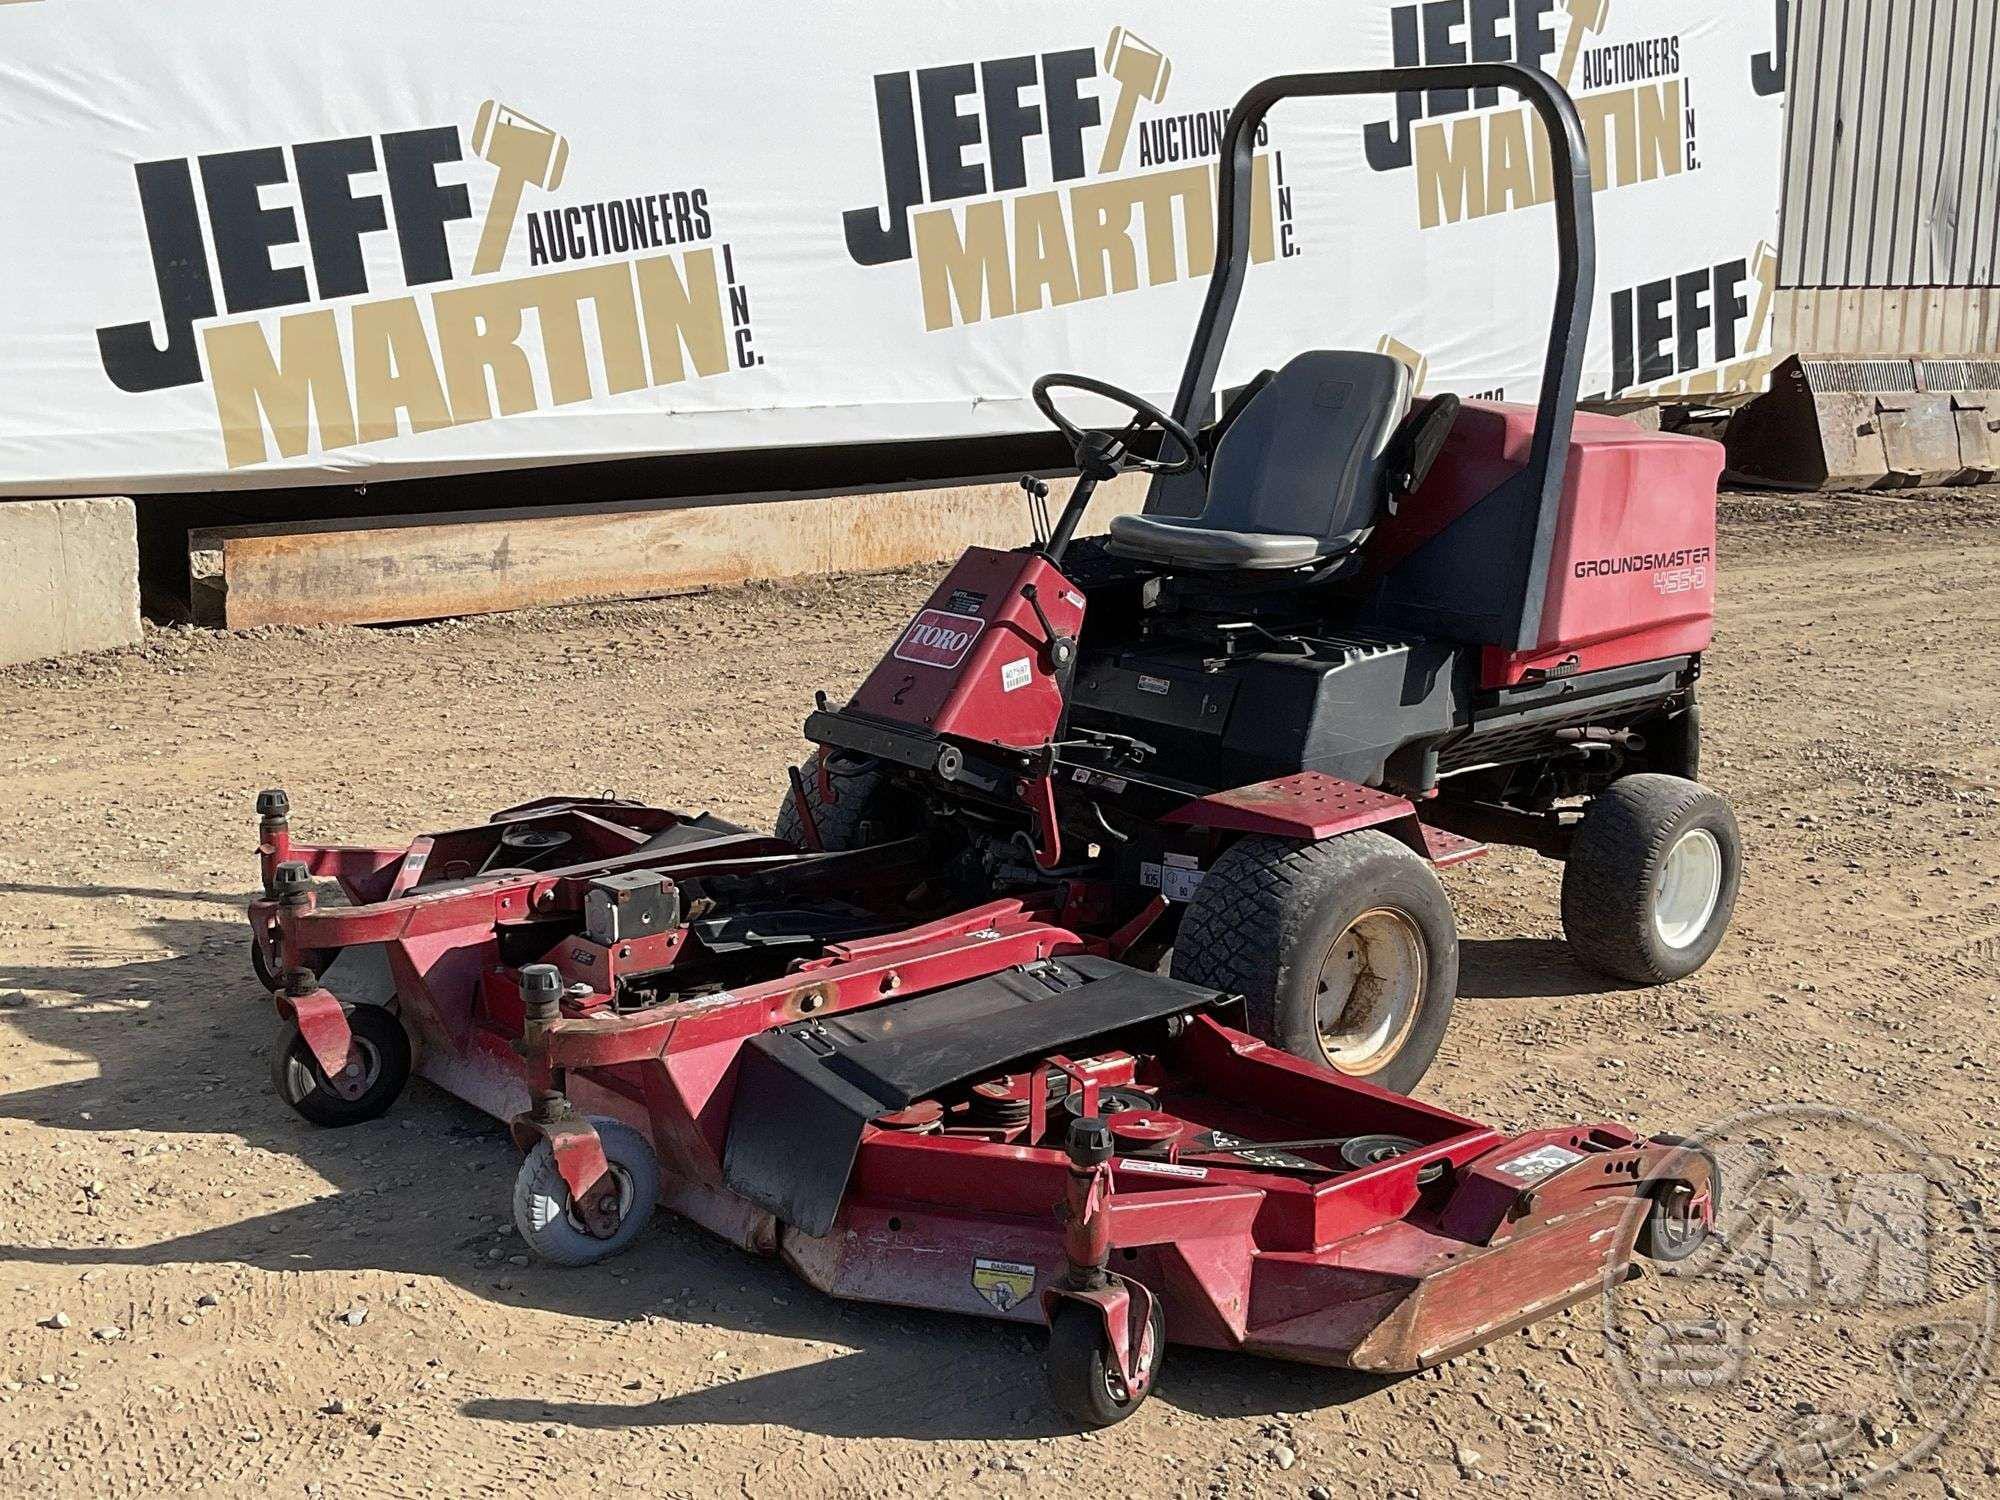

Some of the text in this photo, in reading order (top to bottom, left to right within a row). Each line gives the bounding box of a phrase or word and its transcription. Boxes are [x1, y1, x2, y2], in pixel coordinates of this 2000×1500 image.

[1583, 36, 1680, 90] AUCTIONEERS
[842, 47, 1101, 266] JEFF
[96, 125, 471, 393] JEFF
[527, 188, 712, 266] AUCTIONEERS
[202, 246, 731, 468] MARTIN
[1574, 547, 1711, 578] GROUNDSMASTER
[910, 624, 968, 651] TORO
[991, 1262, 1020, 1271] DANGER
